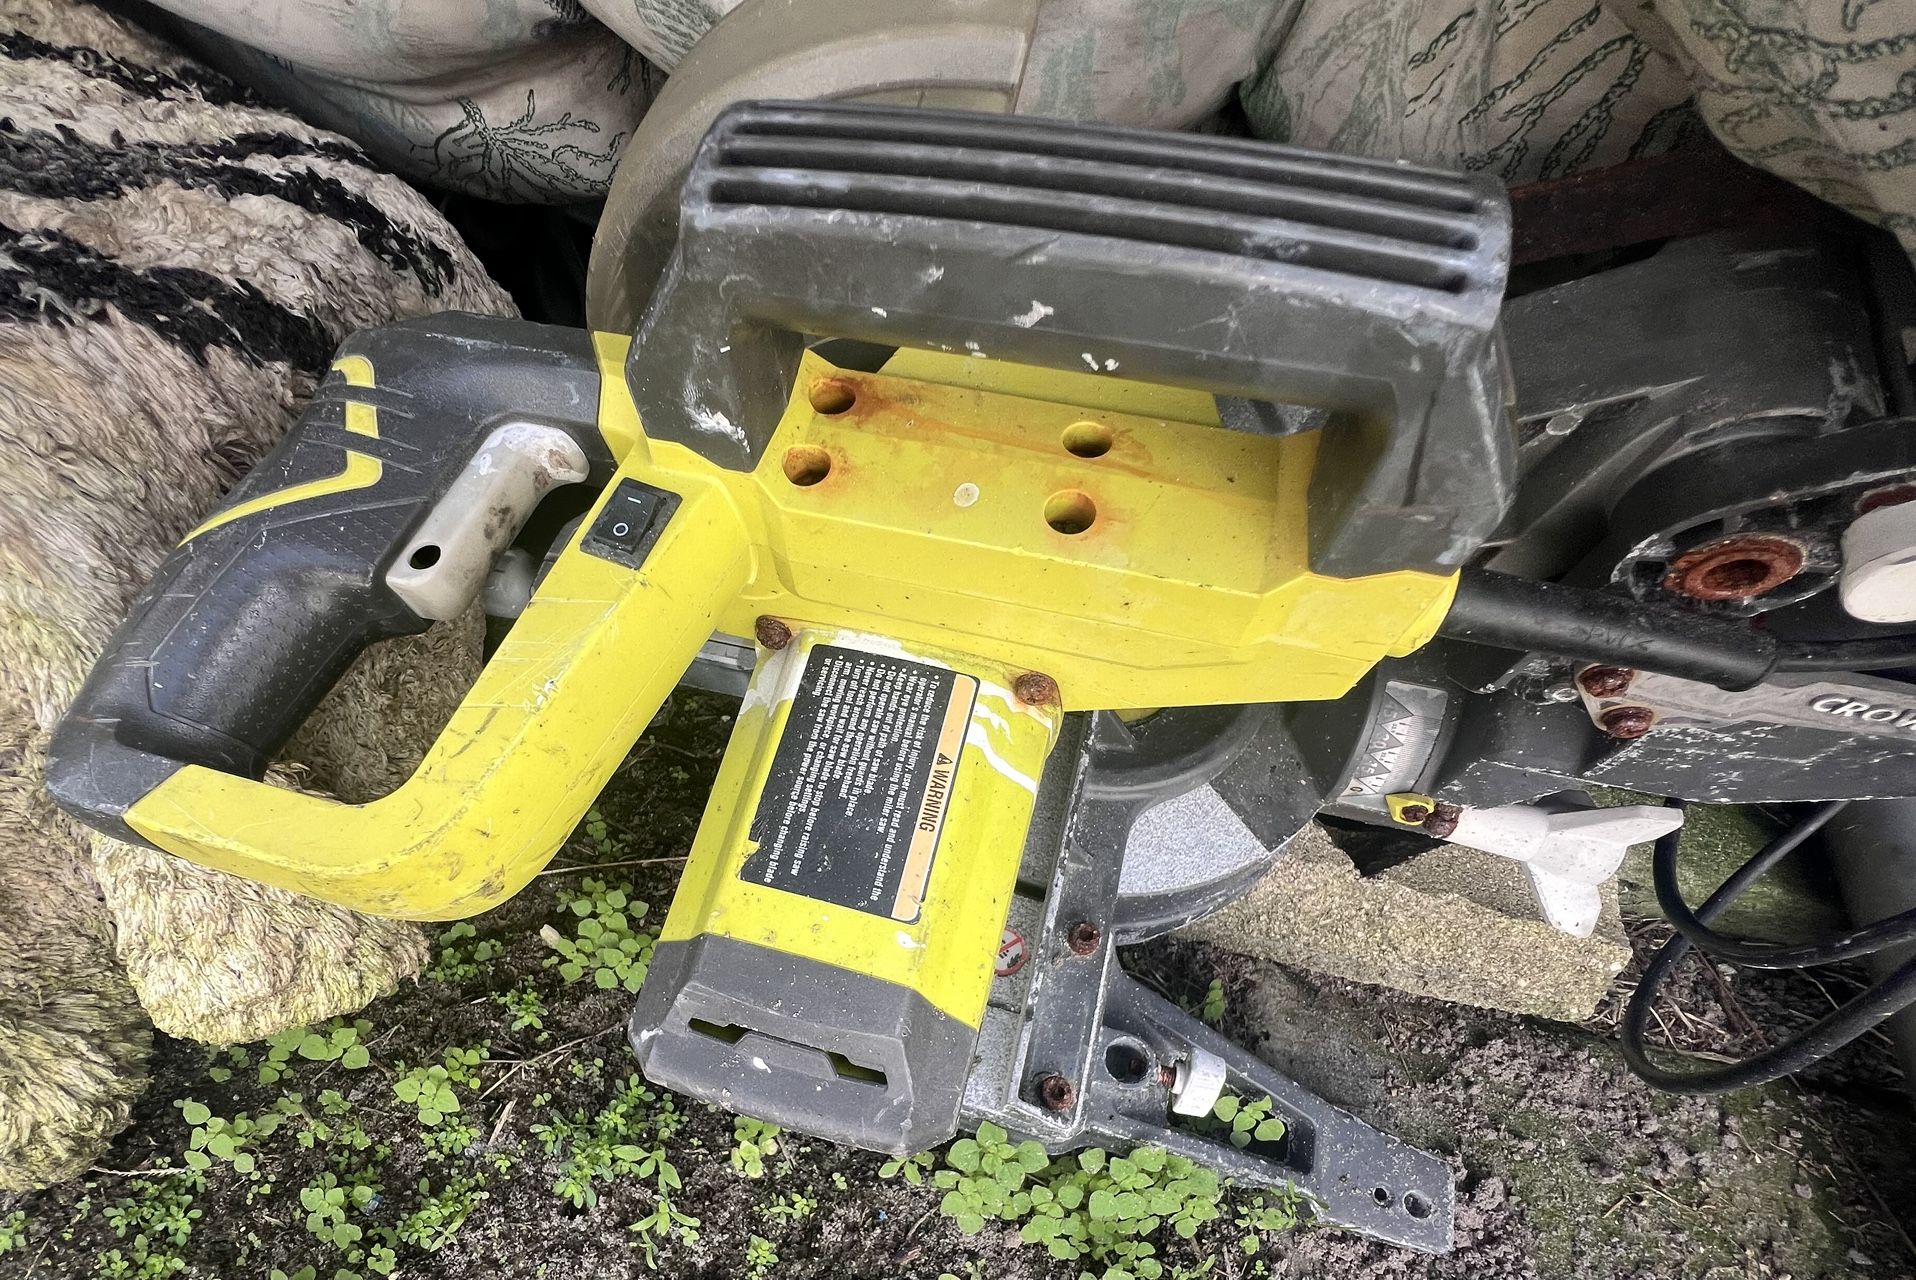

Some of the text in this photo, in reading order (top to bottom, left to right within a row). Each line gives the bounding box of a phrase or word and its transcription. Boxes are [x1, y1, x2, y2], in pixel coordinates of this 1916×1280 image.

[812, 666, 829, 697] servicing.
[852, 665, 864, 679] Turn
[875, 668, 886, 678] Do
[886, 670, 896, 680] Do
[849, 680, 858, 690] off
[871, 678, 881, 690] not
[882, 681, 891, 692] not
[911, 677, 927, 711] operator's
[844, 690, 856, 704] tool
[863, 690, 877, 717] perform
[874, 693, 888, 719] operate
[840, 704, 852, 718] and
[890, 676, 918, 743] Wear eye protection.
[832, 666, 875, 780] Never reach around the saw blade.
[835, 718, 846, 734] wait
[857, 718, 869, 731] any
[863, 672, 907, 795] Keep hands out of path of saw blade.
[870, 719, 880, 734] saw
[904, 712, 917, 738] manual
[797, 661, 852, 814] arm, moving workpiece, or changing settings.
[832, 734, 842, 744] for
[861, 735, 876, 761] without
[827, 745, 837, 760] saw
[897, 738, 911, 761] before
[764, 660, 843, 883] Disconnect the saw from the power source before changing blade
[820, 760, 834, 780] blade
[854, 761, 867, 786] guards
[889, 762, 903, 782] using
[838, 766, 856, 799] freehand.
[870, 680, 940, 901] To reduce the risk of injury, user must read and understand the
[887, 783, 899, 795] the
[811, 790, 823, 806] stop
[844, 795, 858, 817] place.
[919, 770, 949, 831] WARNING
[804, 807, 819, 831] before
[876, 817, 887, 834] saw.
[794, 832, 810, 859] raising
[790, 859, 801, 876] saw
